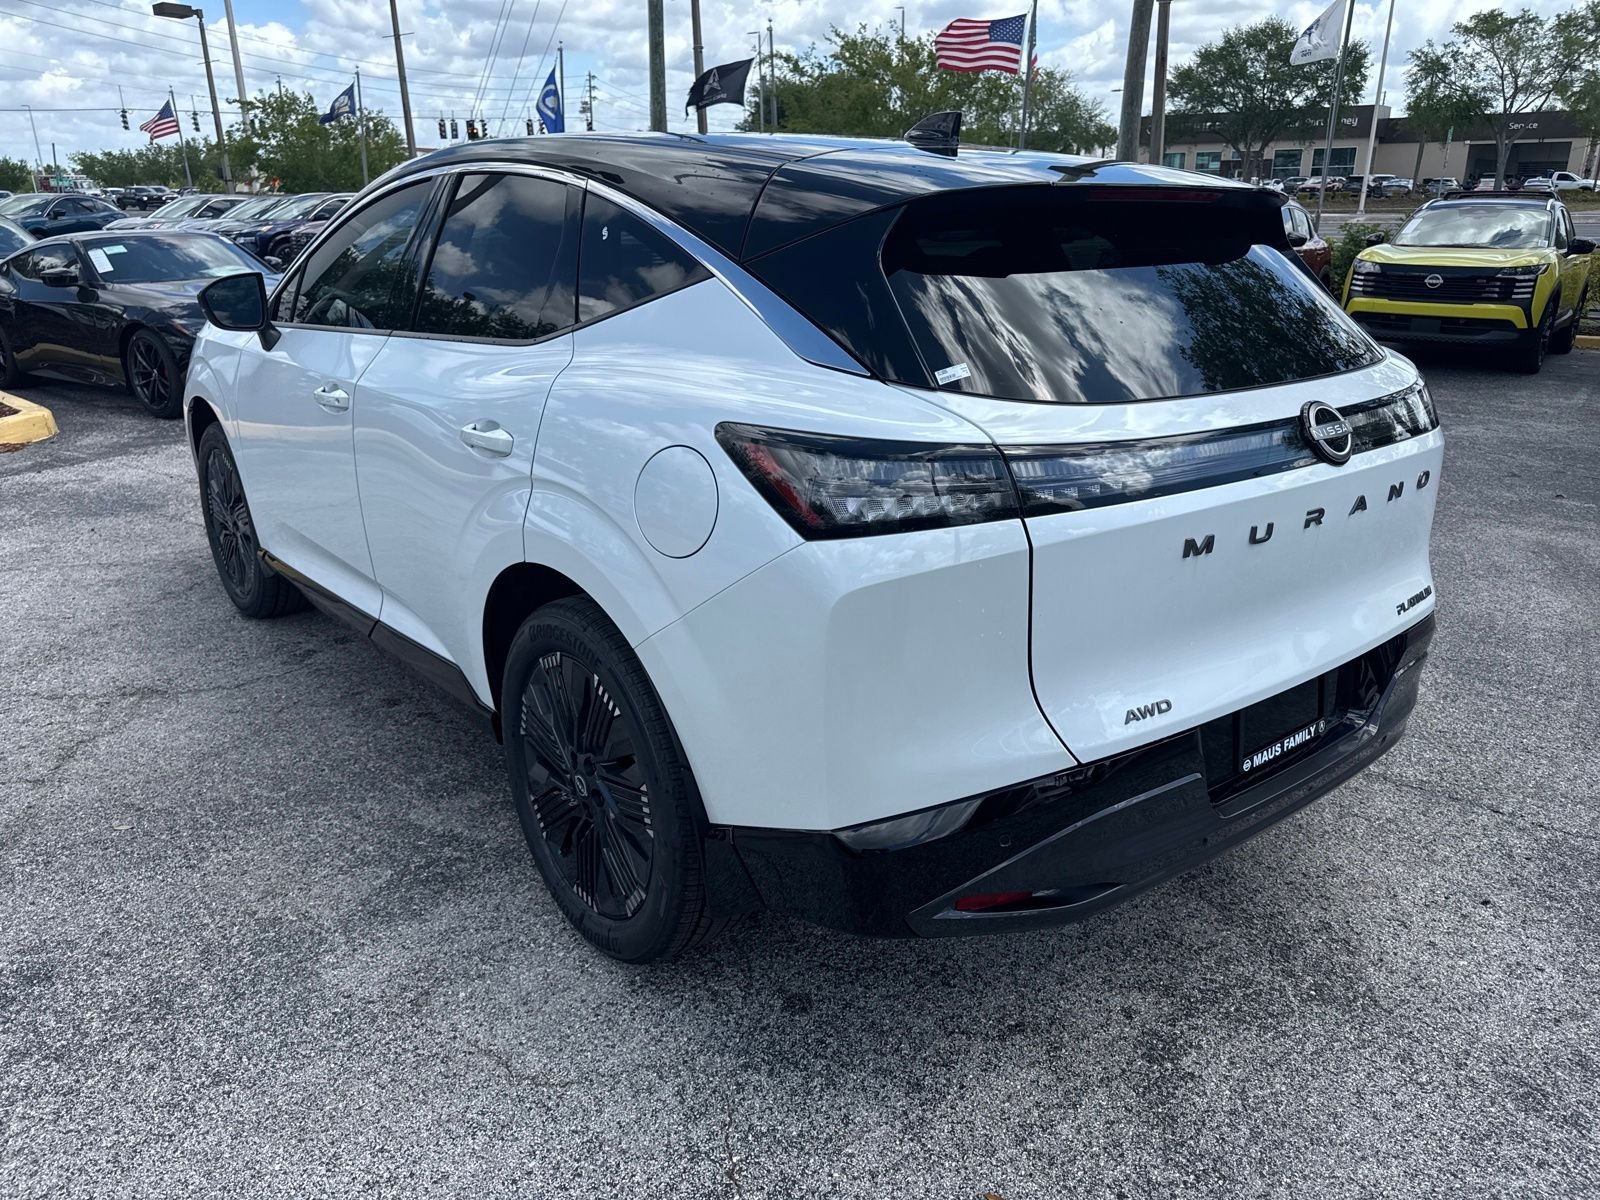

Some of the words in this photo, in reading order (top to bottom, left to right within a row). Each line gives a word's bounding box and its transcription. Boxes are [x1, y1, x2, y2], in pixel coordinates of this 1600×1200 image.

[1182, 470, 1431, 558] MURANO
[528, 623, 602, 669] BRIDGESTONE
[1124, 699, 1172, 725] AWD
[1253, 743, 1282, 767] MAUS
[1283, 724, 1316, 752] FAMILY
